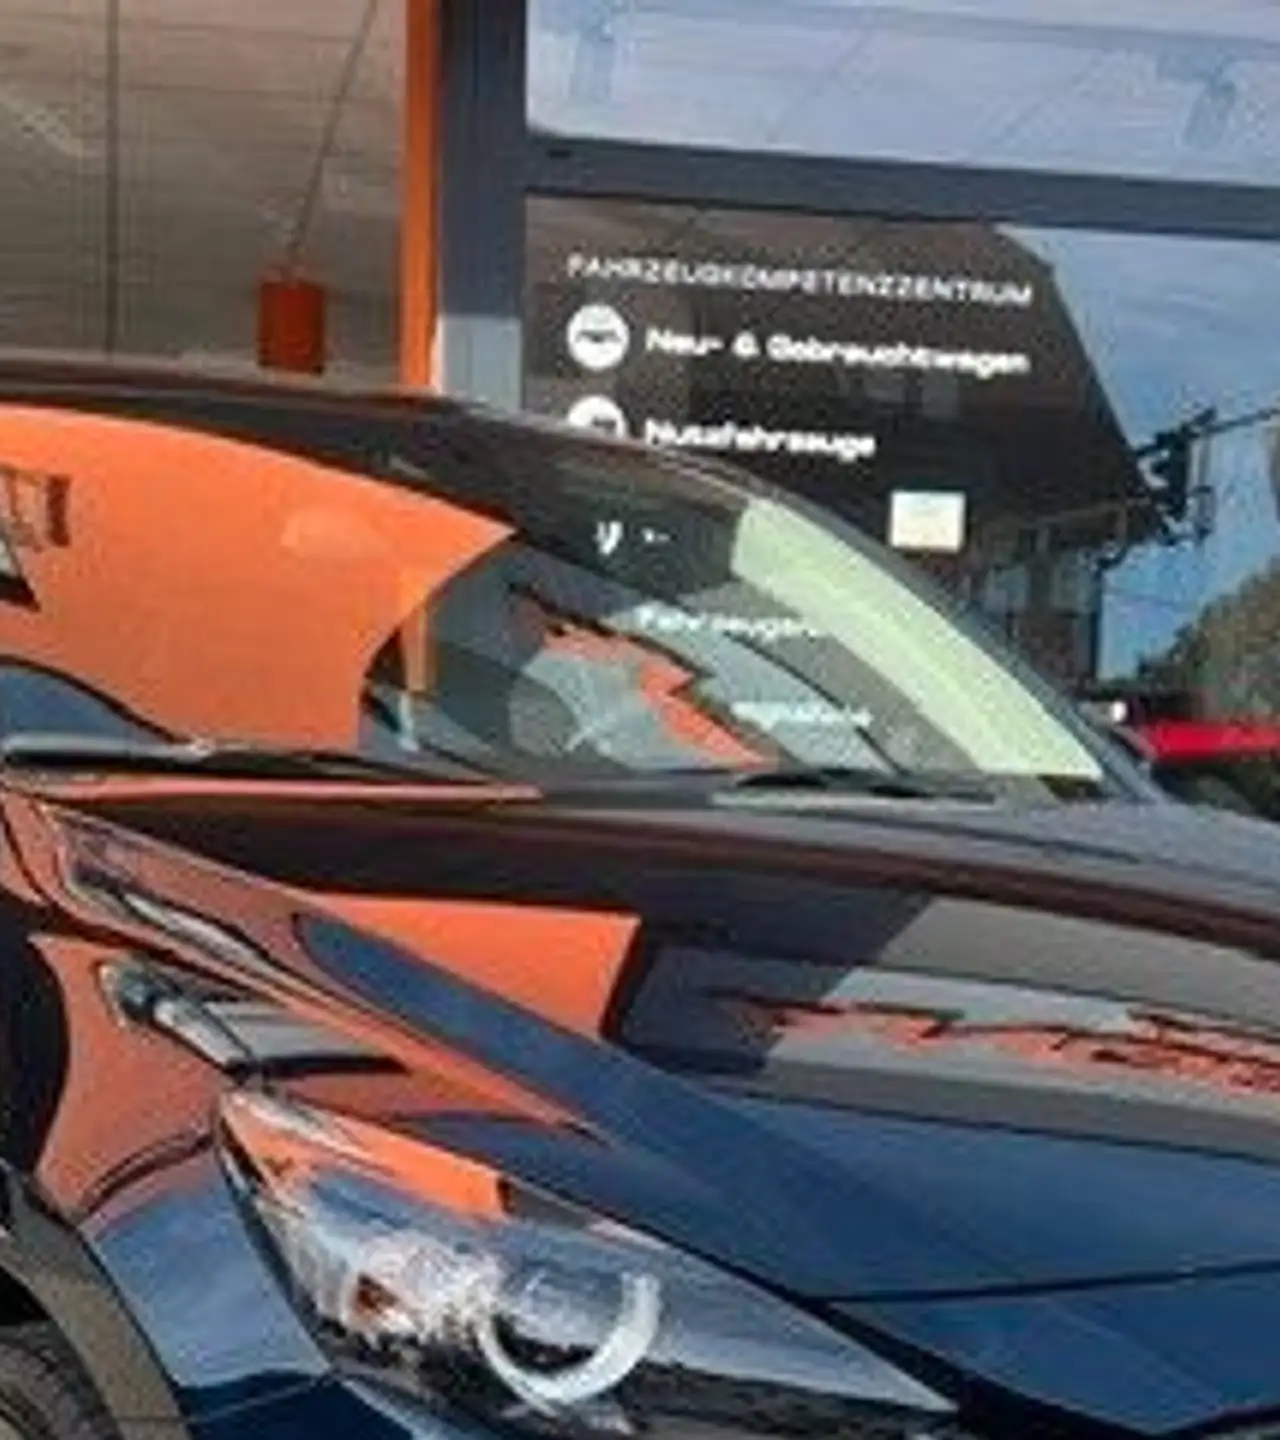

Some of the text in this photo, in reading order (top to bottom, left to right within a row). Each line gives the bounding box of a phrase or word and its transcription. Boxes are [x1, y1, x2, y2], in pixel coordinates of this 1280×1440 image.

[568, 255, 1032, 303] FAHRZEUGKOMPETENZZENTRUM
[646, 328, 723, 357] Neu-
[767, 334, 1030, 379] Gebrauchtwagen
